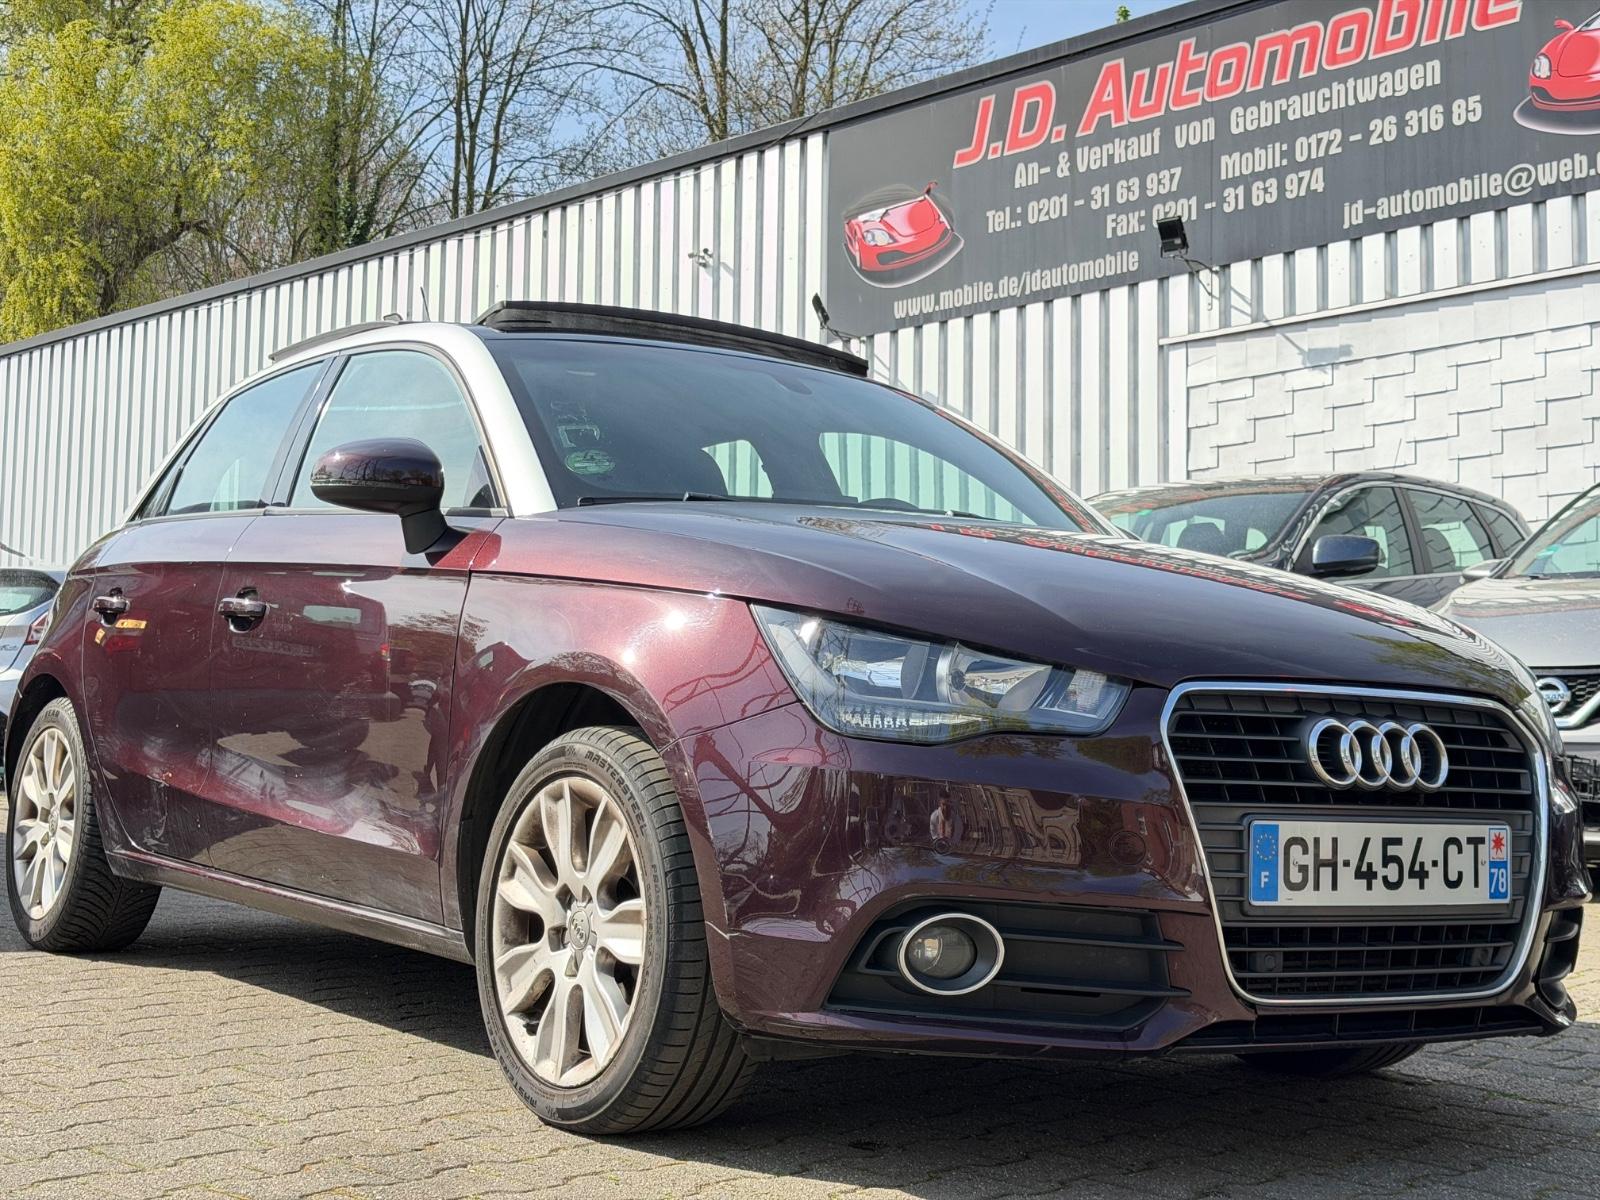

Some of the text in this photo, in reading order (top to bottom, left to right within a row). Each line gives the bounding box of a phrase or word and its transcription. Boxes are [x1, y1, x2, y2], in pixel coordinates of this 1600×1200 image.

[952, 80, 1067, 169] J.D.
[1014, 59, 1441, 189] An- & Verkauf von Gebrauchtwagen
[1220, 95, 1482, 181] Mobil: 0172 - 26 316 85
[986, 166, 1182, 235] Tel.: 0201 - 31 63 937
[1106, 209, 1146, 239] Fax:
[1152, 195, 1197, 228] 0201
[1223, 184, 1244, 213] 31
[1251, 177, 1278, 206] 63
[1285, 167, 1324, 199] 974
[1343, 151, 1600, 229] jd-automobile@web.
[893, 250, 1139, 320] www.mobile.de/jdautomobile
[584, 750, 647, 837] MASTERSTEEL
[1260, 871, 1270, 889] F
[1283, 836, 1486, 892] GH-454-CT
[1490, 868, 1507, 893] 78
